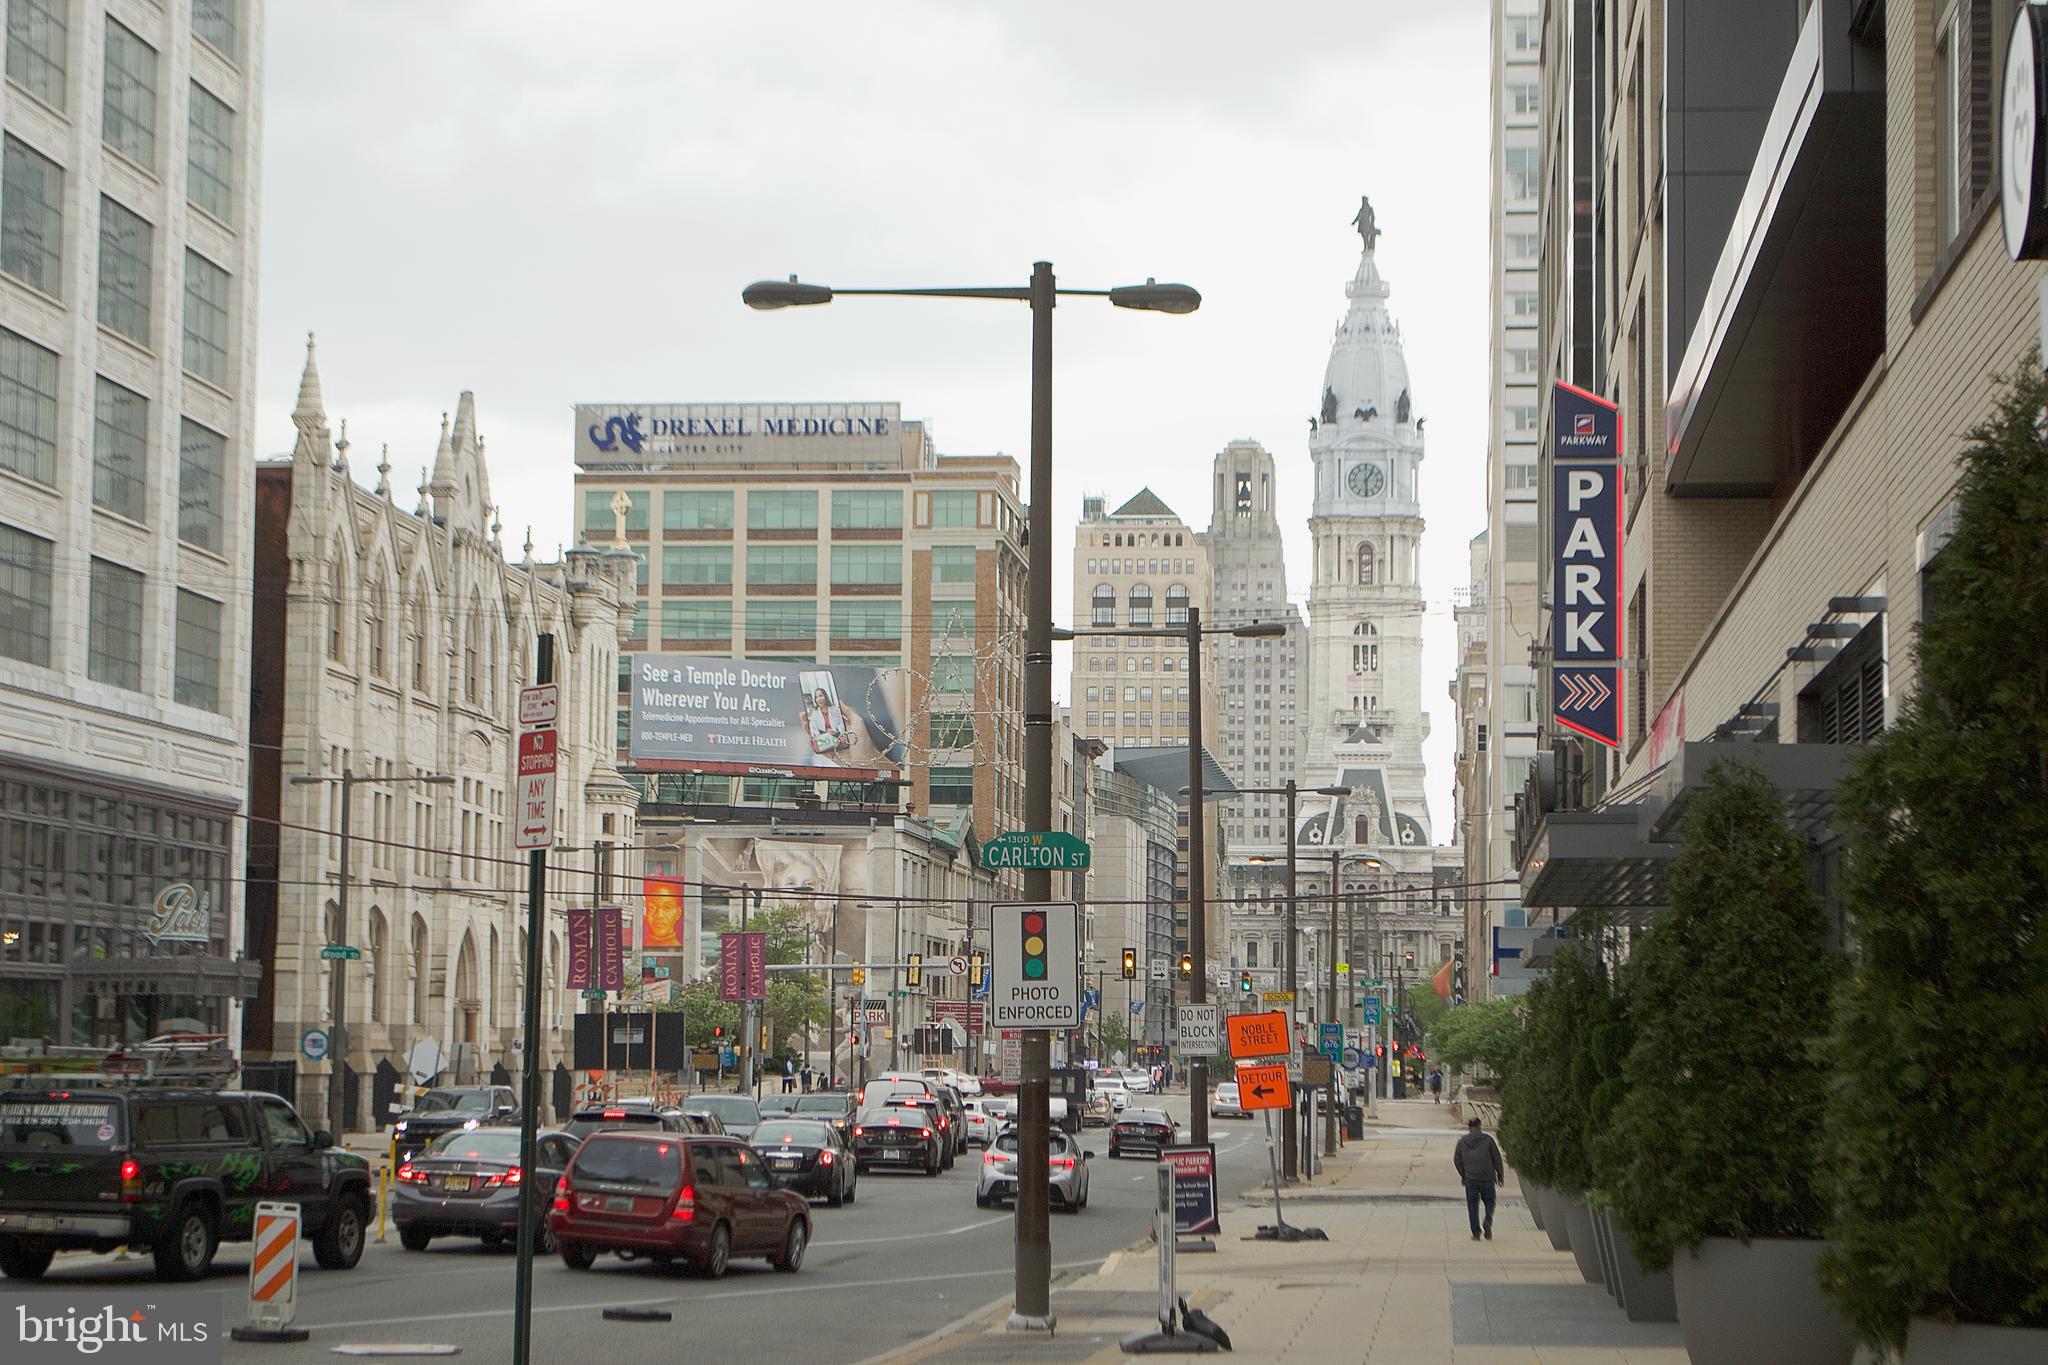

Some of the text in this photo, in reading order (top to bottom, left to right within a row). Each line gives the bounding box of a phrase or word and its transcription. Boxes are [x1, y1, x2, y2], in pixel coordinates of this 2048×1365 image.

[653, 417, 889, 436] DREXEL MEDICINE
[1561, 434, 1608, 446] PARKWAY
[716, 444, 744, 454] CITY
[1562, 470, 1605, 652] PARK
[642, 663, 787, 690] See a Temple Doctor
[642, 687, 771, 712] Wherever You Are.
[642, 711, 786, 729] Telemedicine Appointments for All Specialties
[533, 735, 544, 750] NO
[752, 736, 787, 748] HEALTH
[521, 752, 554, 771] STOPPING
[528, 779, 546, 798] ANY
[527, 801, 546, 820] TIME
[988, 846, 1084, 866] CARLTON ST
[322, 951, 347, 959] Wood
[572, 914, 586, 984] ROMAN
[606, 912, 617, 986] CATHOLIC
[726, 936, 738, 996] ROMAN
[751, 937, 760, 996] CATHOLIC
[1012, 987, 1059, 1000] PHOTO
[999, 1006, 1073, 1020] ENFORCED
[1180, 1010, 1215, 1022] DO NOT
[1180, 1026, 1216, 1038] BLOCK
[1240, 1023, 1276, 1035] NOBLE
[1181, 1040, 1216, 1049] INTERSECTION
[1240, 1034, 1278, 1046] STREET
[1324, 1040, 1339, 1048] 676
[1242, 1072, 1283, 1084] DETOUR
[1186, 1155, 1210, 1166] PARKING
